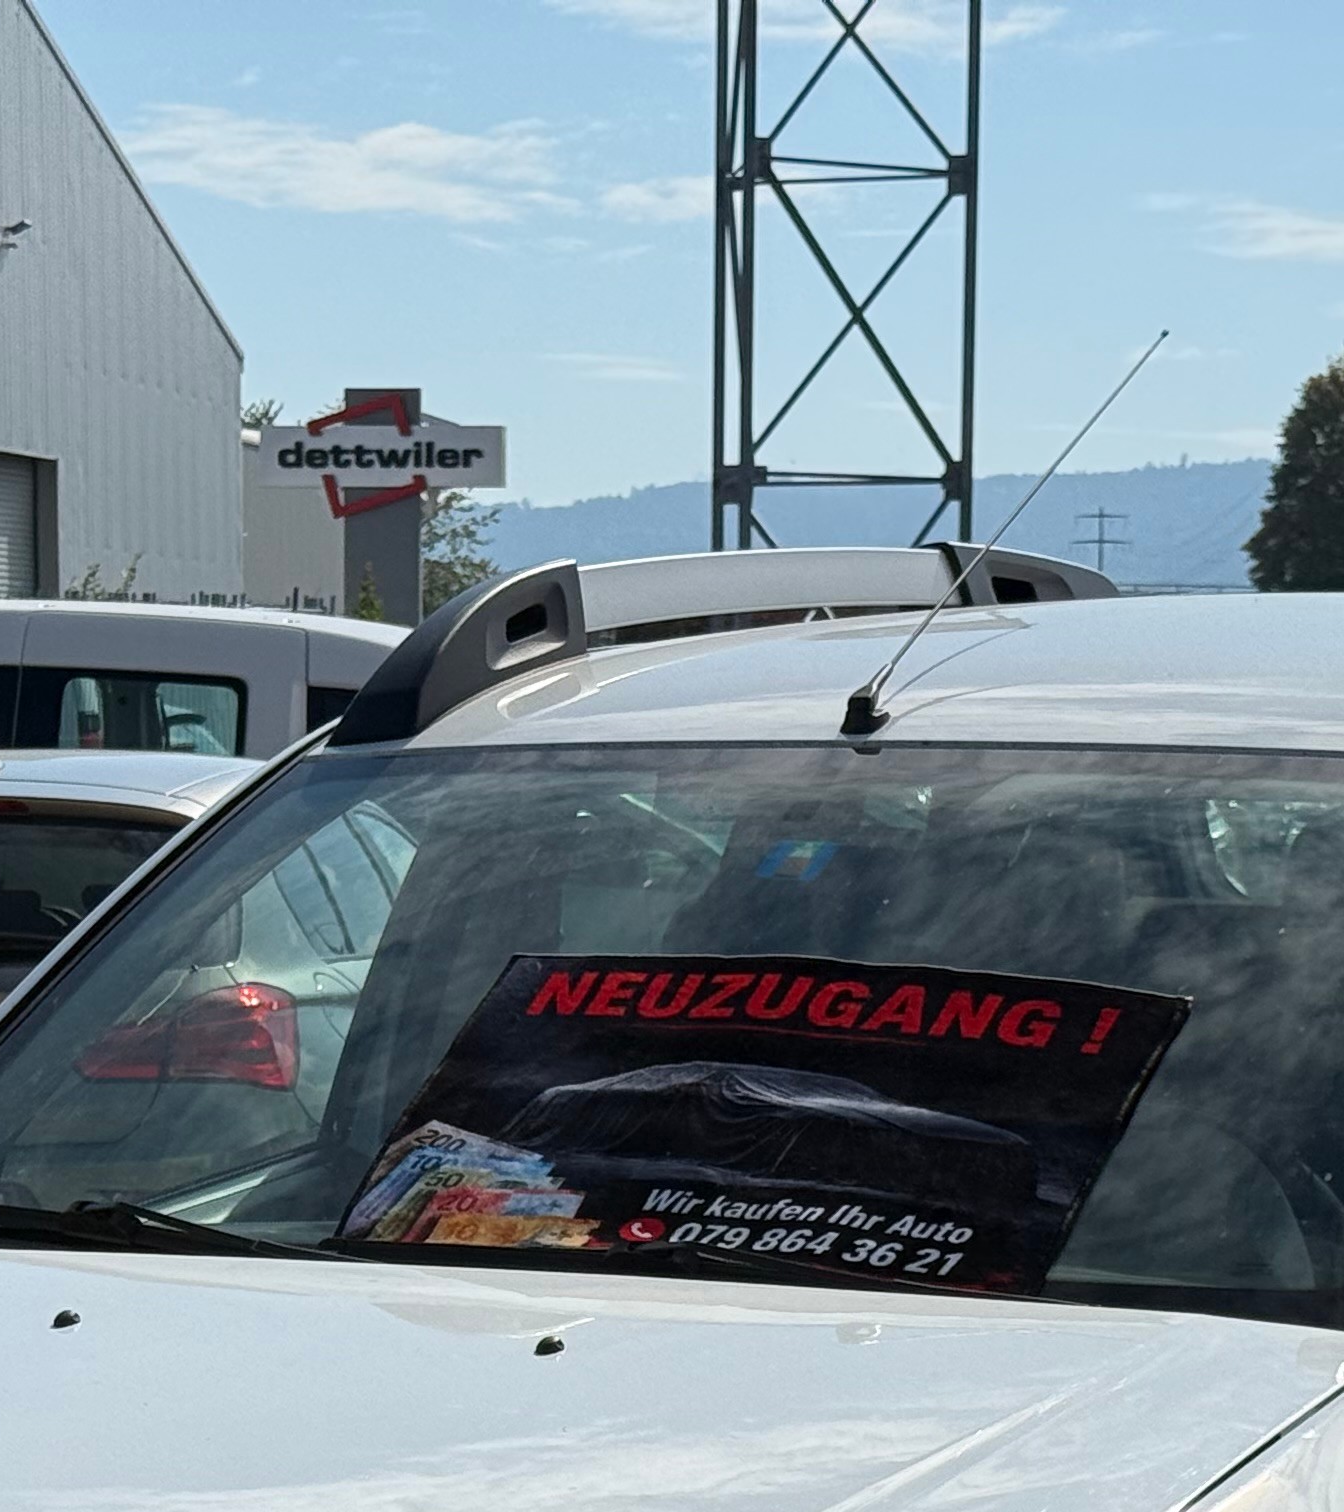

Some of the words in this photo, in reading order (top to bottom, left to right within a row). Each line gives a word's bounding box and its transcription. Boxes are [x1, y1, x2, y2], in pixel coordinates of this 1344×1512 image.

[277, 441, 485, 469] dettwiler
[526, 970, 1063, 1049] NEUZUGANG
[1082, 1007, 1121, 1055] !
[414, 1129, 467, 1152] 200
[424, 1171, 466, 1188] 50
[437, 1194, 479, 1212] 20
[641, 1188, 705, 1215] Wir
[703, 1195, 826, 1223] kaufen
[828, 1204, 886, 1232] Ihr
[884, 1215, 974, 1245] Auto
[668, 1222, 752, 1250] 079
[752, 1228, 841, 1254] 864
[841, 1238, 905, 1267] 36
[903, 1247, 965, 1277] 21
